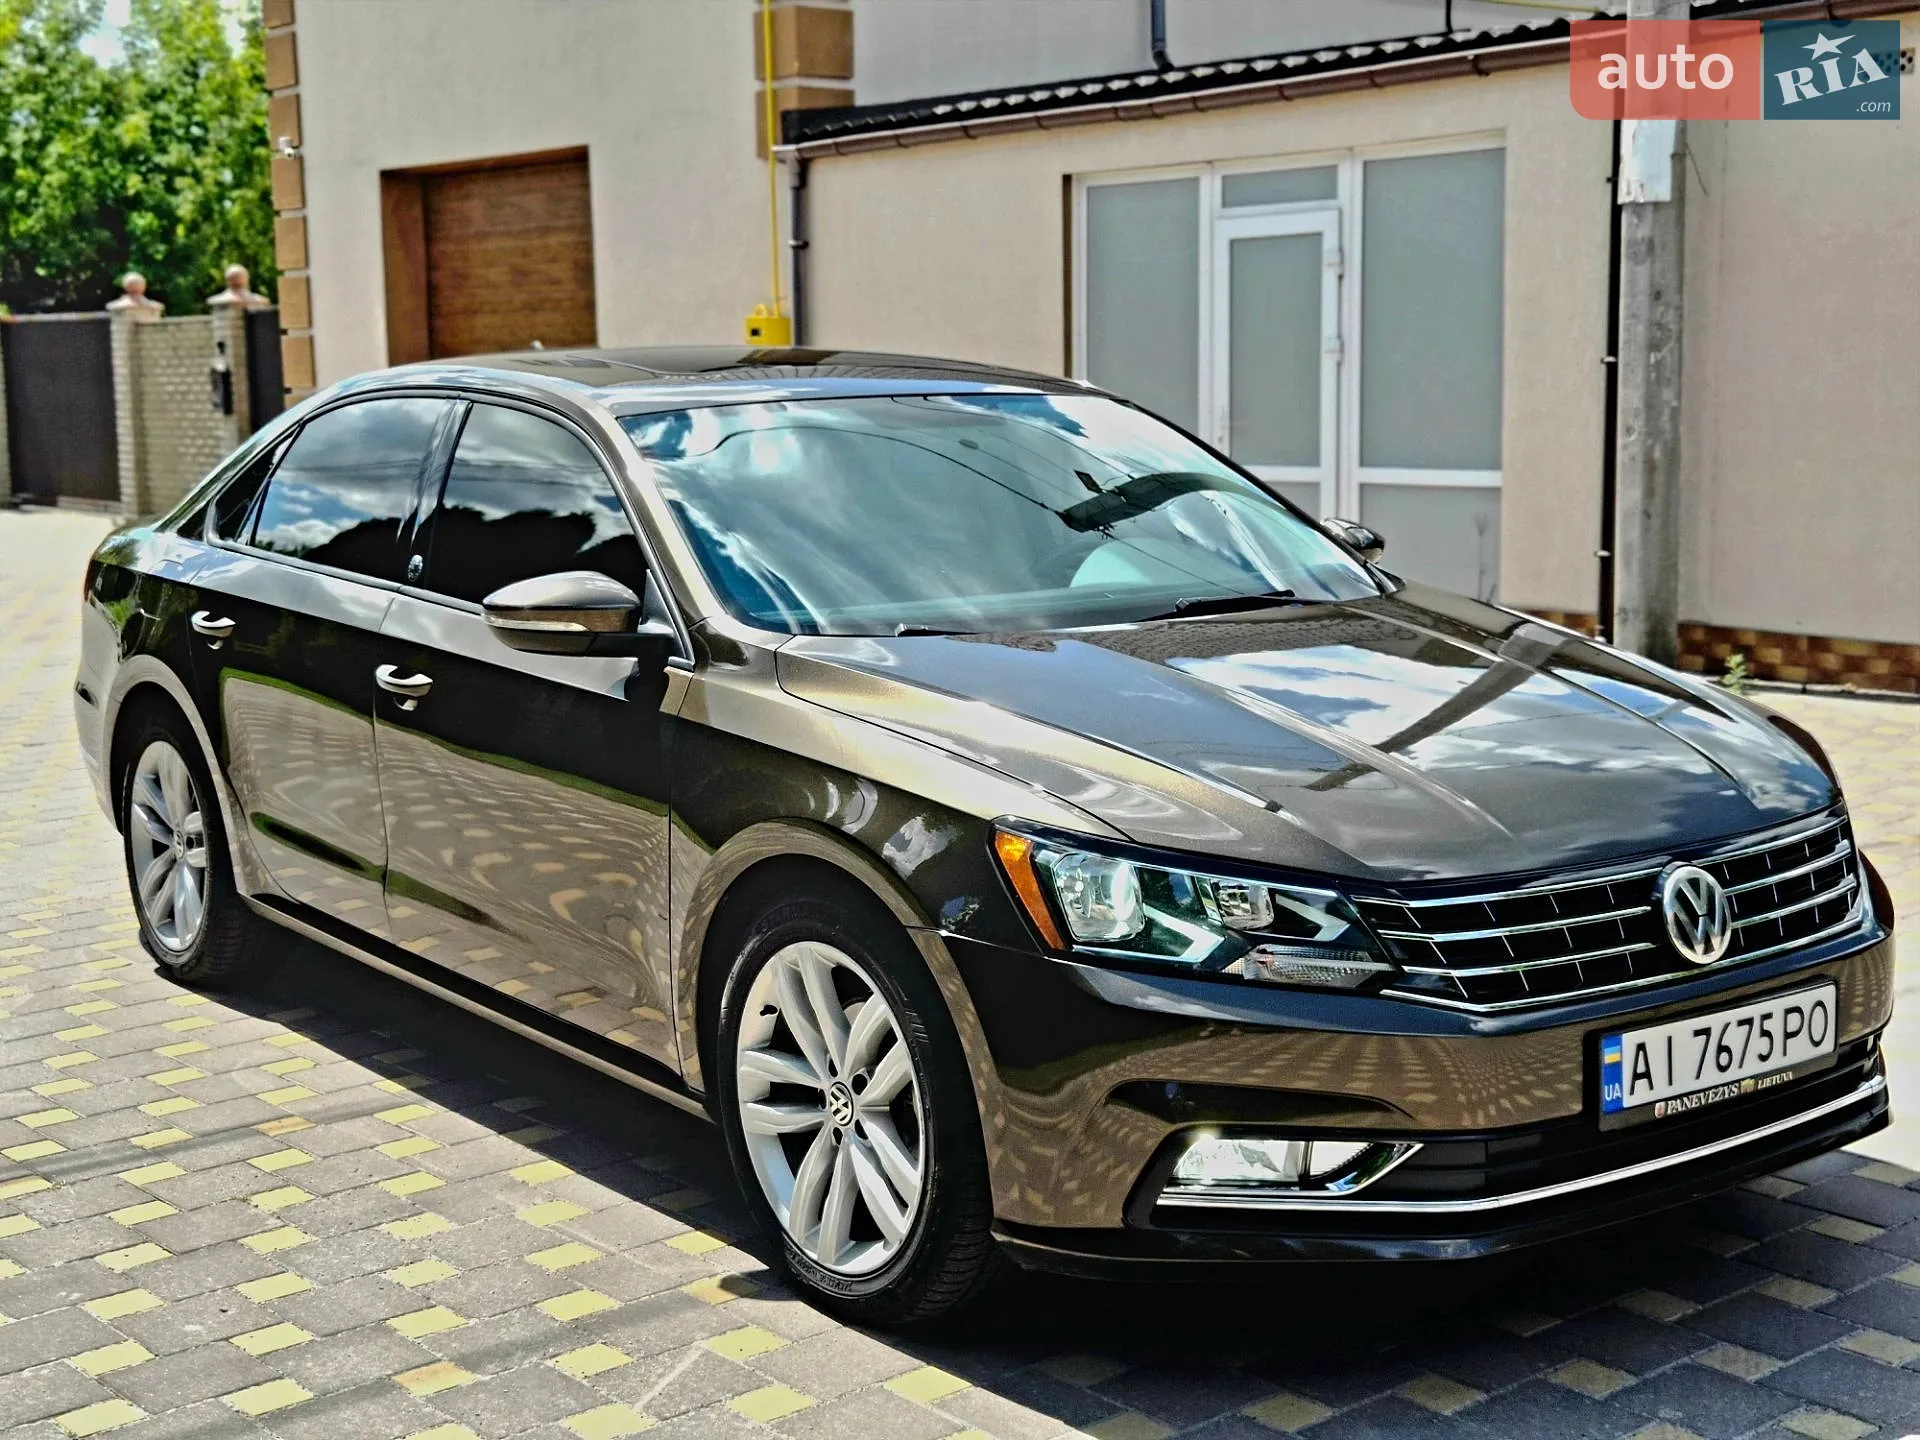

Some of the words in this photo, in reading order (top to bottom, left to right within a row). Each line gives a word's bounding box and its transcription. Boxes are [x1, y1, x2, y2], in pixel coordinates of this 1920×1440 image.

[1629, 1036, 1673, 1096] AI
[1693, 1013, 1774, 1079] 7675
[1783, 1000, 1829, 1057] PO
[1757, 1071, 1793, 1090] LIETUVA
[1604, 1084, 1622, 1101] UA
